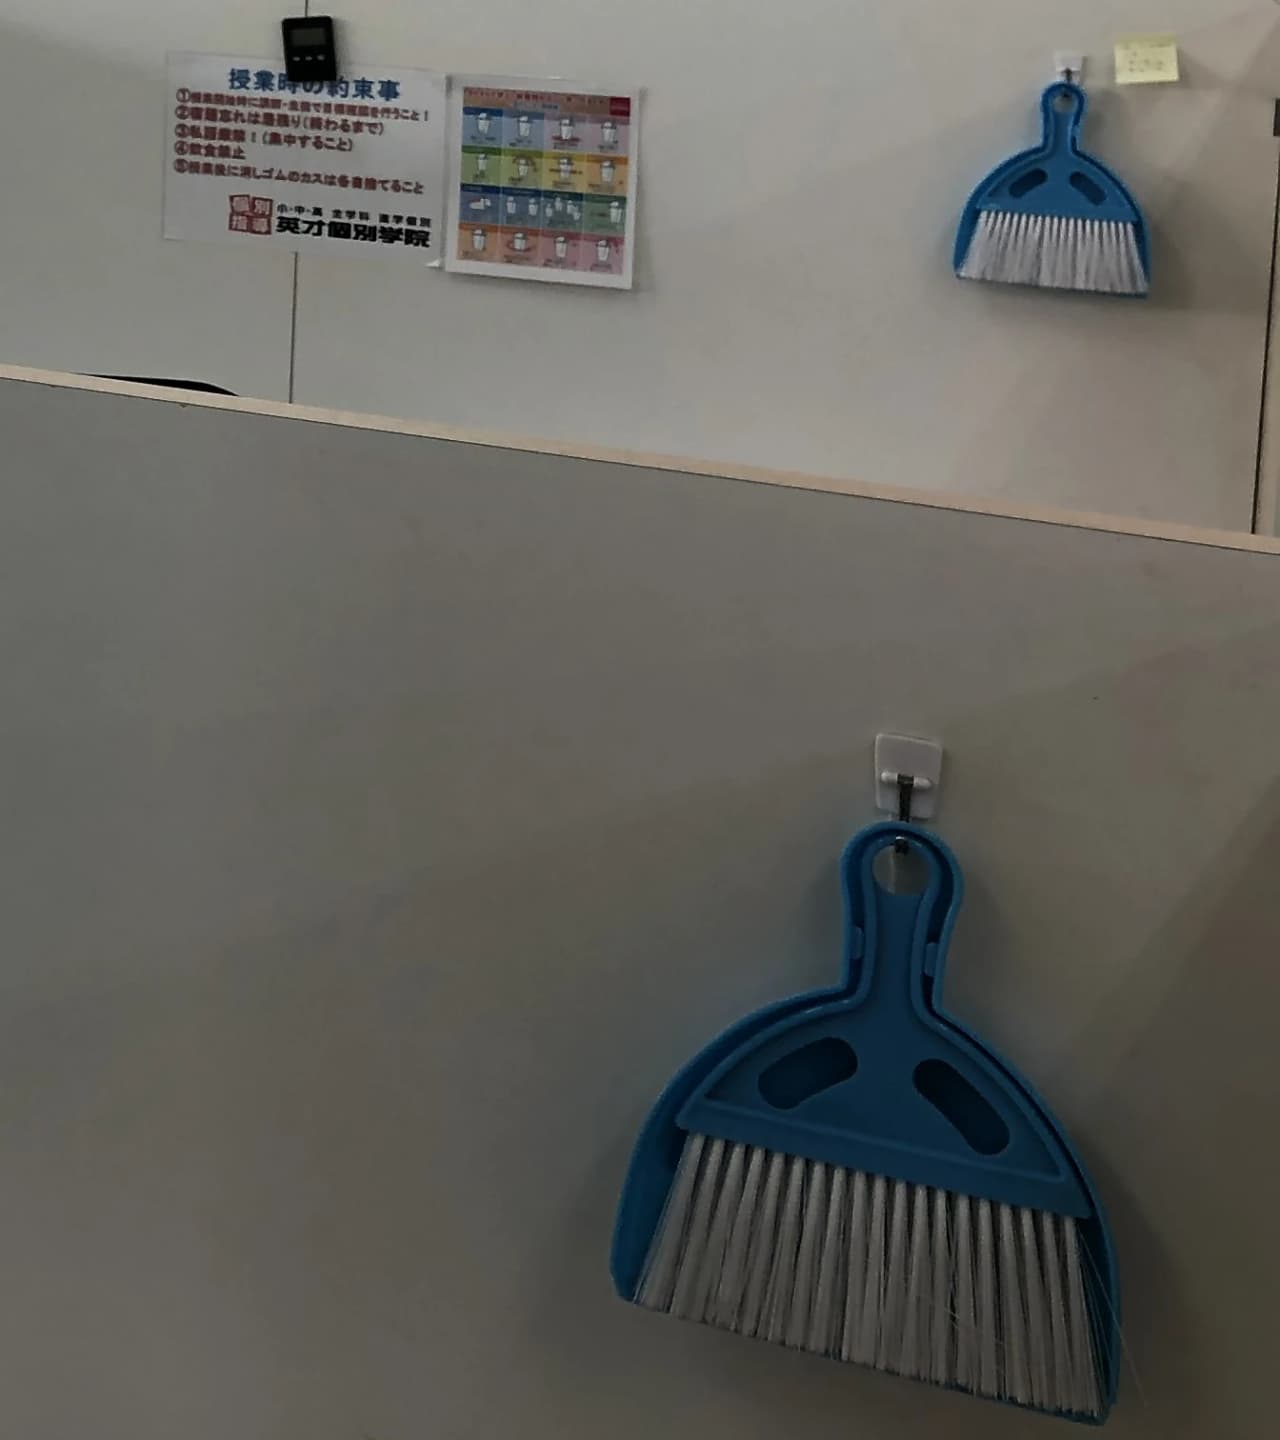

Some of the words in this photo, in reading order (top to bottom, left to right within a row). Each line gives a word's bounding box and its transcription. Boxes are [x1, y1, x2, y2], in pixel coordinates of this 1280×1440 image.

[276, 216, 431, 249] 英才個別学院
